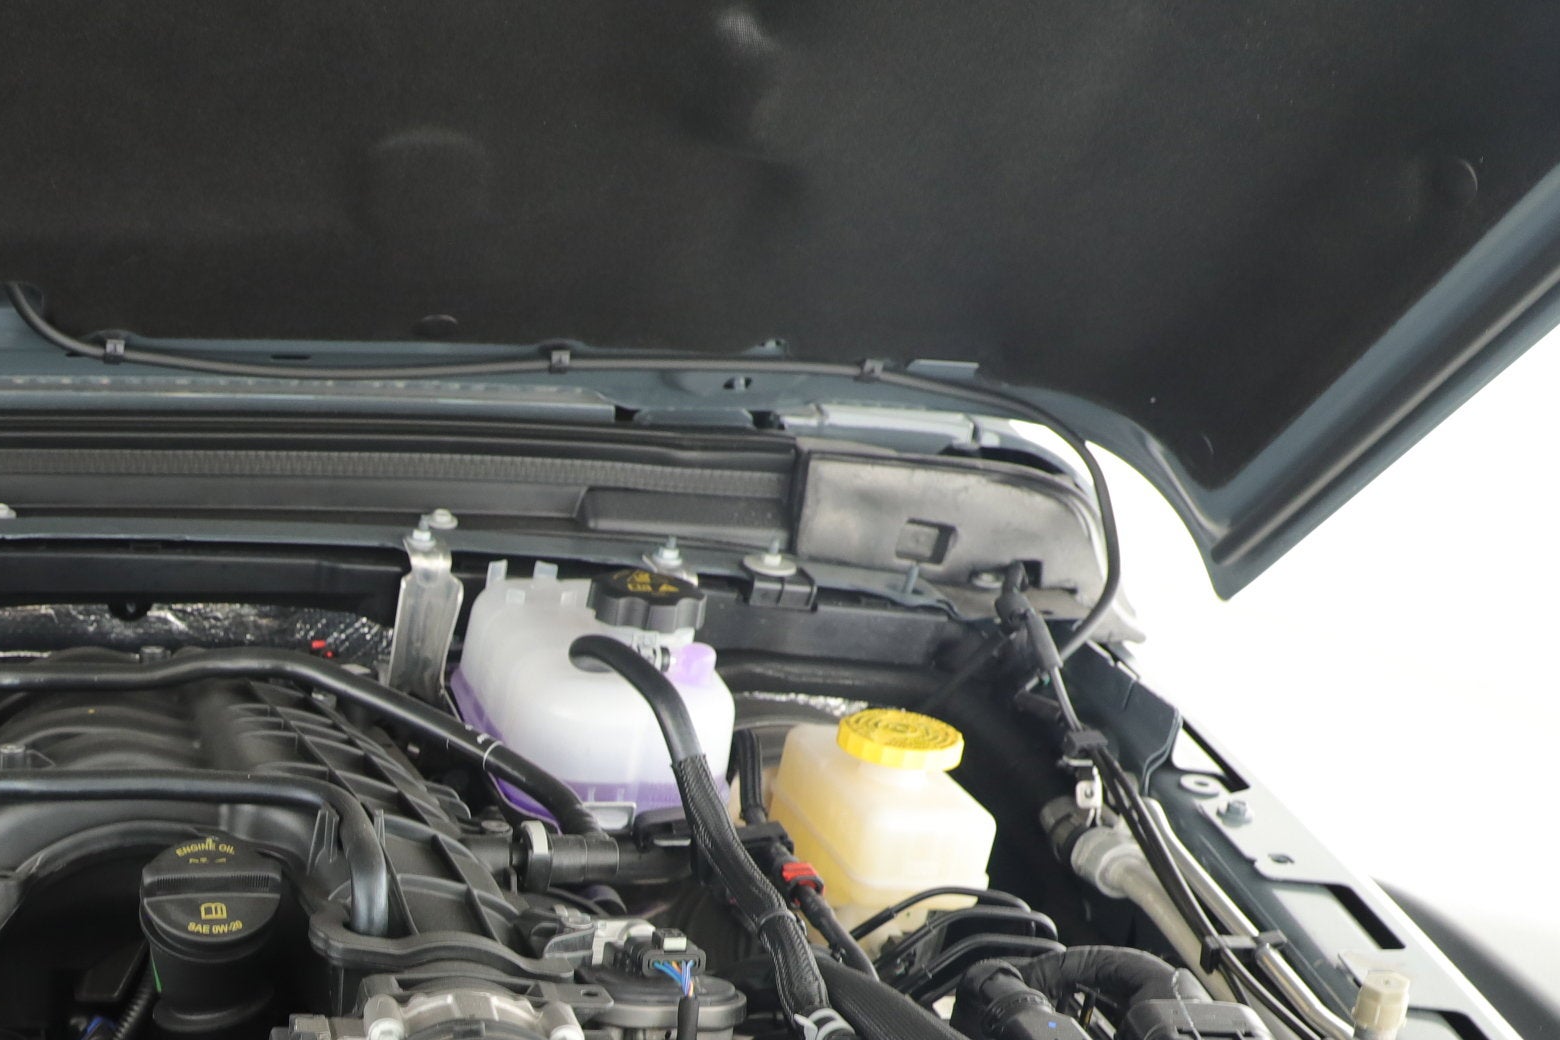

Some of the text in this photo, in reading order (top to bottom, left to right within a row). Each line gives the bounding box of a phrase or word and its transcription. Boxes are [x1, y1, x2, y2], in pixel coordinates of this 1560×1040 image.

[176, 842, 235, 857] ENGINE OIL
[187, 920, 243, 934] SAE 0W-20
